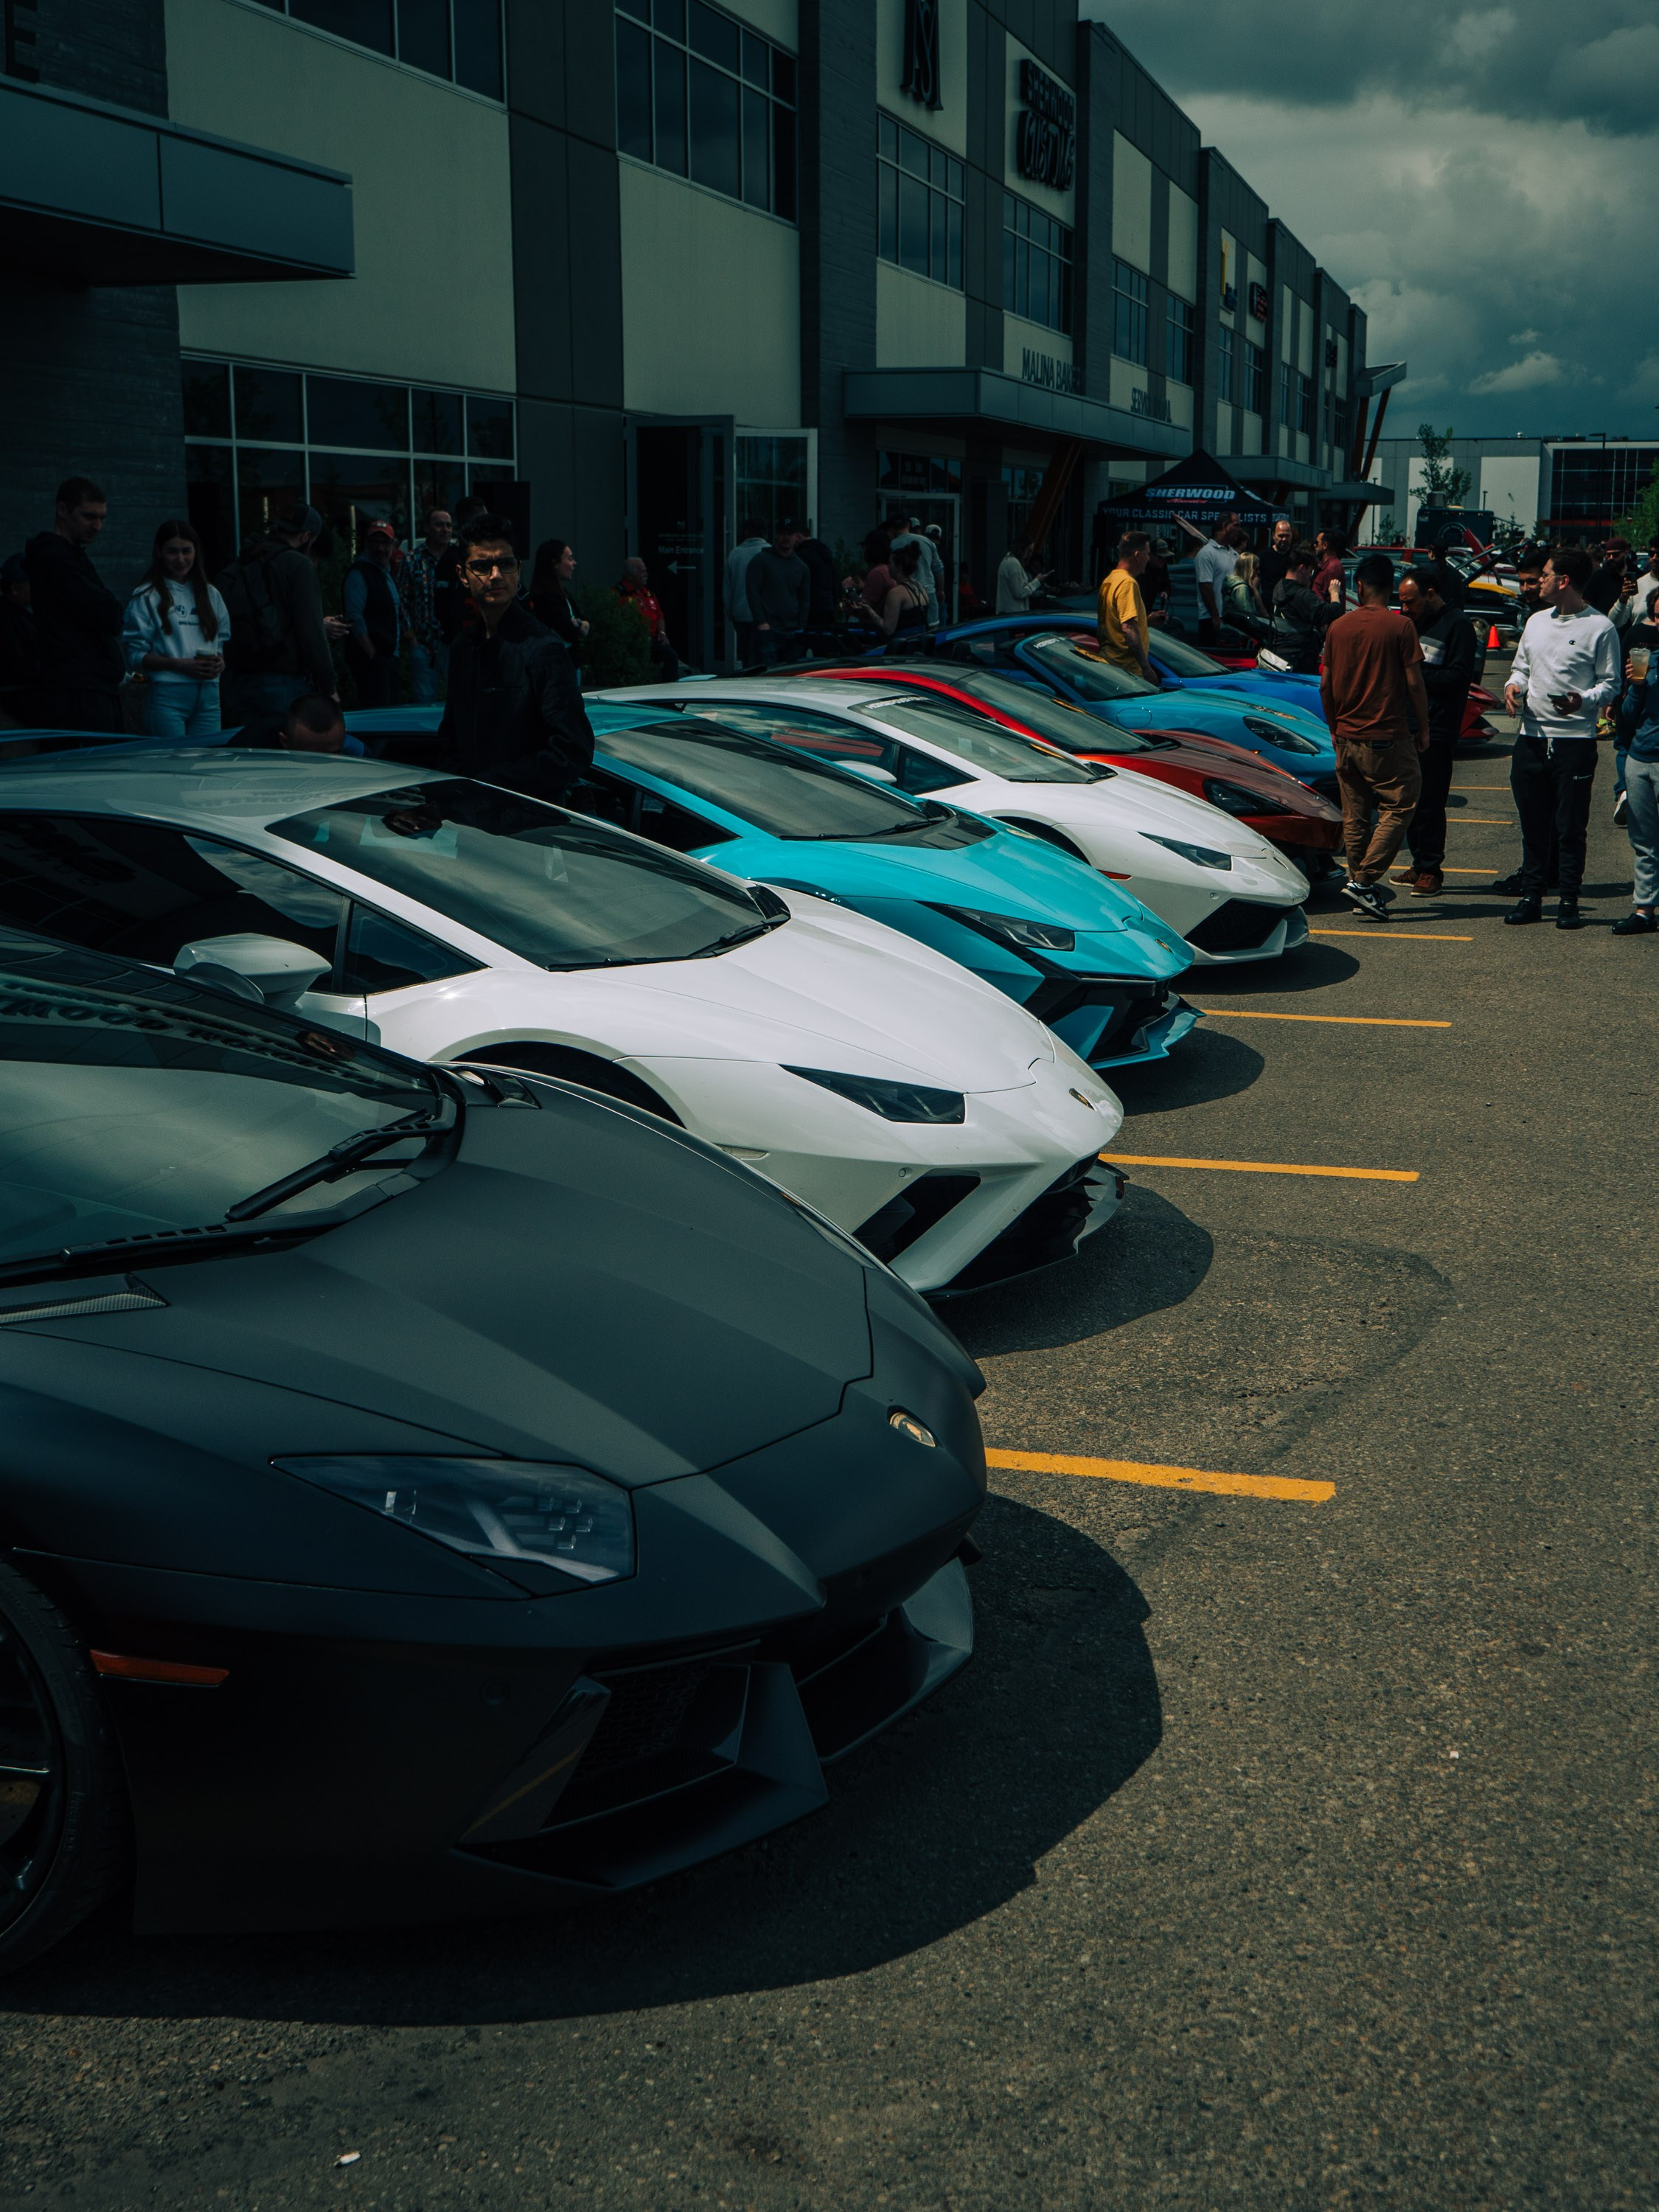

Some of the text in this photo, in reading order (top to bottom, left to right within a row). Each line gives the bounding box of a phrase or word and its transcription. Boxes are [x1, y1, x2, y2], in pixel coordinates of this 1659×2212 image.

[1022, 347, 1054, 389] MALINA
[1145, 487, 1235, 501] SHERWOOD
[1178, 509, 1198, 520] CAR
[1200, 510, 1267, 522] SPELISTS
